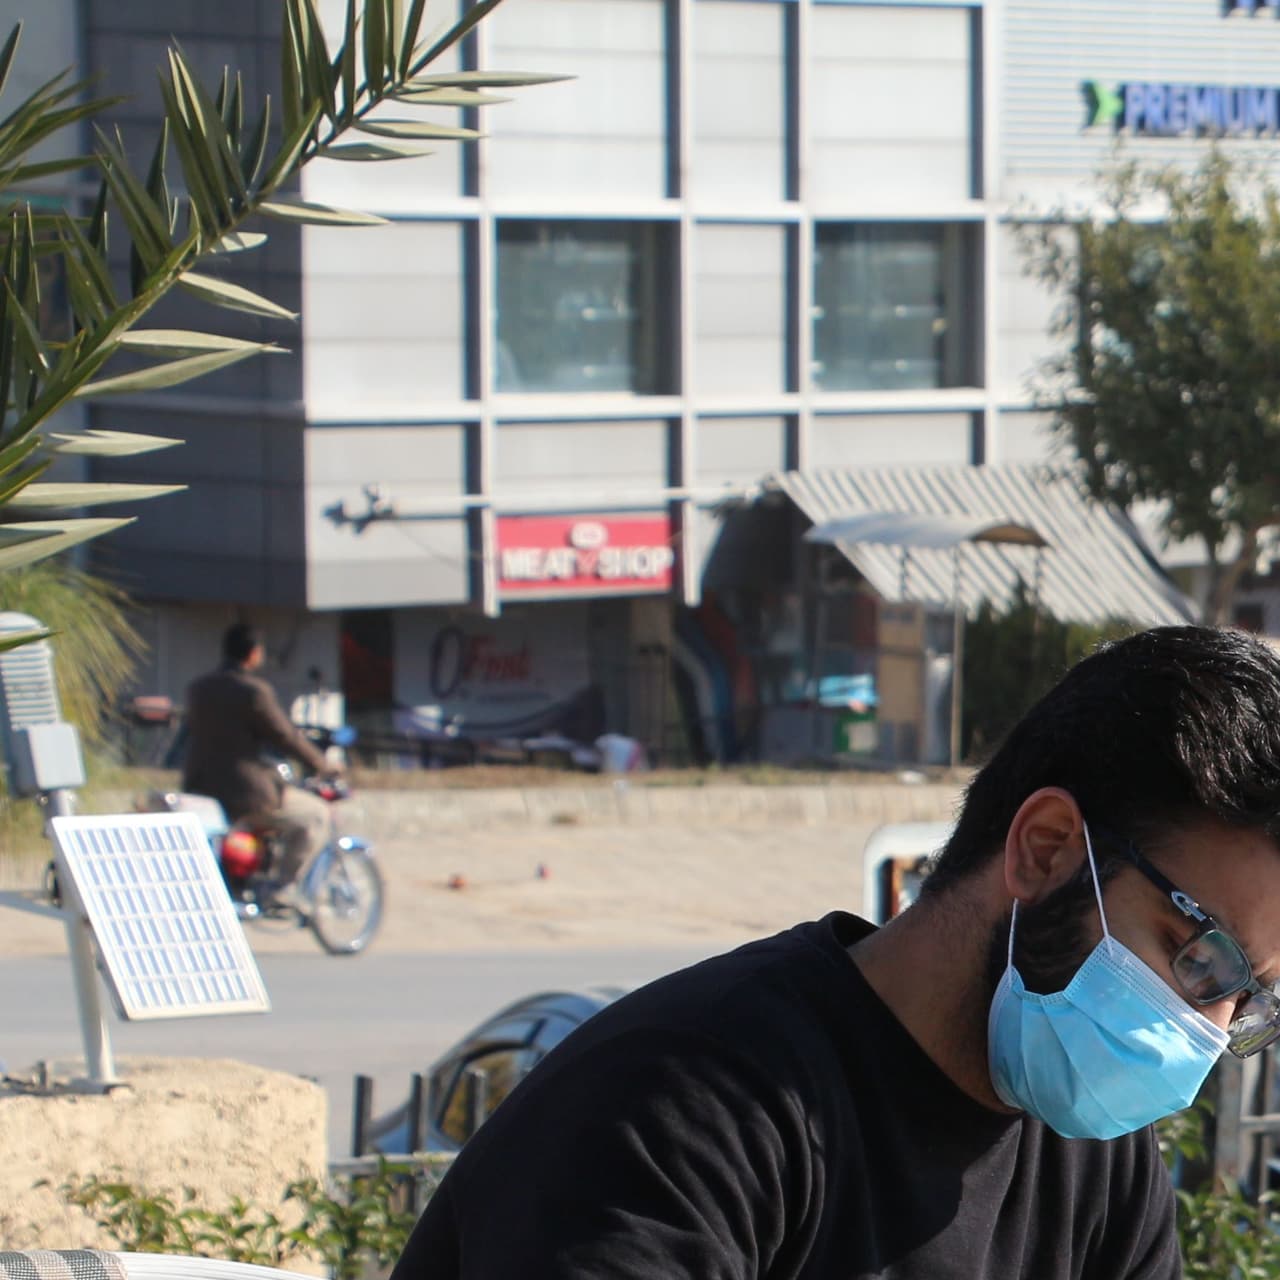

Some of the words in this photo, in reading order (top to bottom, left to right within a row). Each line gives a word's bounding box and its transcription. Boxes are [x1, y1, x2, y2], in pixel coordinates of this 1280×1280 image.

[1120, 83, 1279, 137] PREMIUM
[502, 547, 576, 581] MEAT
[597, 545, 674, 579] SHOP
